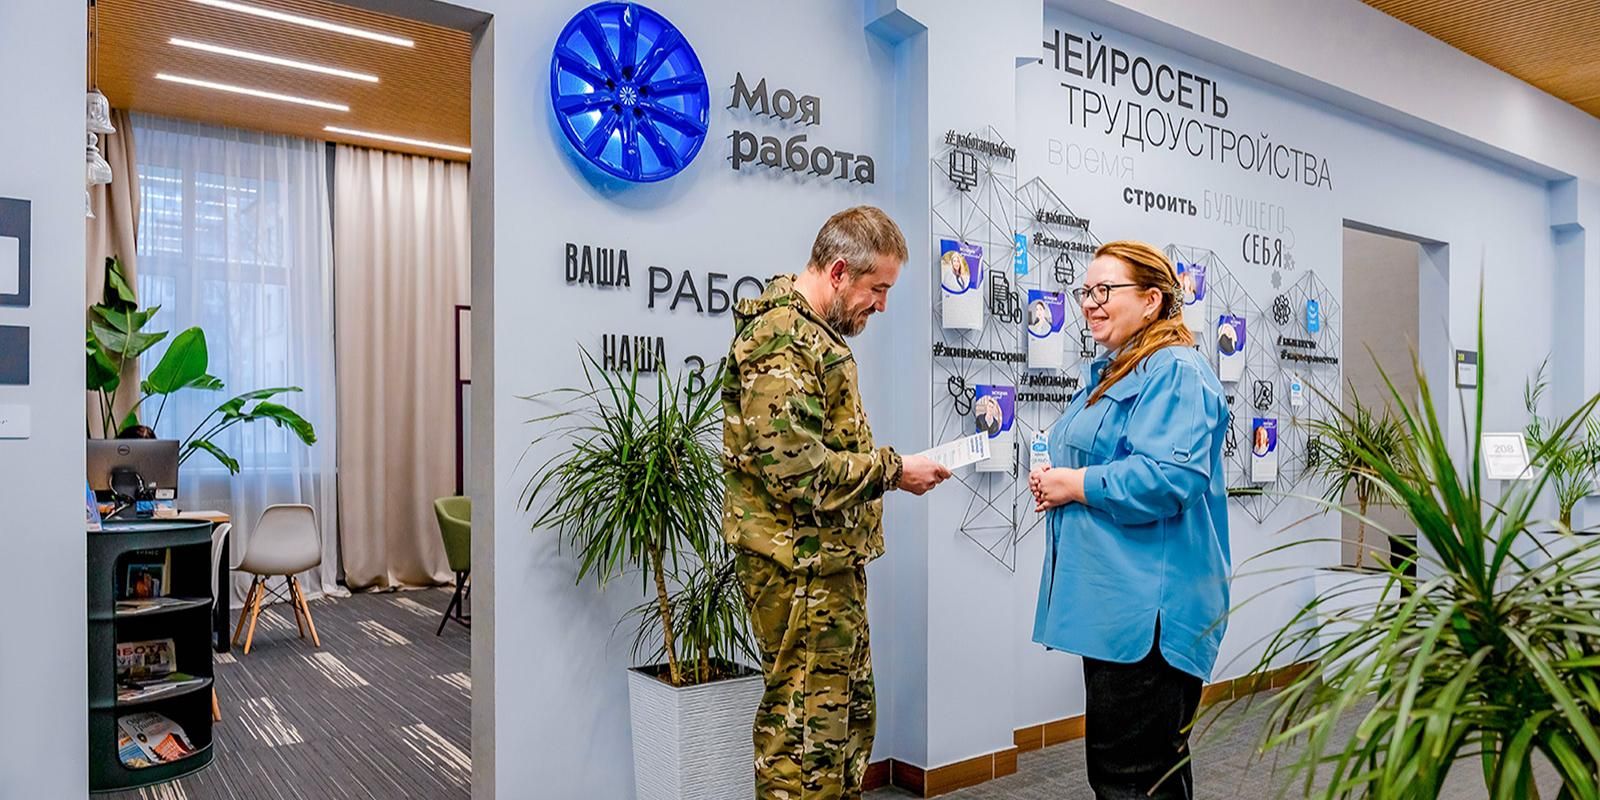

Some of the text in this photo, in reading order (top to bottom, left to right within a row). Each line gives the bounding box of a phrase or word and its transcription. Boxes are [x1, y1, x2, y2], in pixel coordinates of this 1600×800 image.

[1038, 28, 1229, 119] НЕЙРОСЕТЬ
[730, 71, 821, 126] Моя
[730, 129, 875, 185] работа
[1047, 138, 1135, 181] время
[1060, 81, 1333, 191] ТРУДОУСТРОЙСТВА
[1122, 186, 1286, 234] строить БУДУЩЕГО
[565, 242, 631, 288] ВАША
[1242, 232, 1283, 268] СЕБЯ
[648, 265, 774, 314] РАБО
[602, 333, 668, 374] НАША
